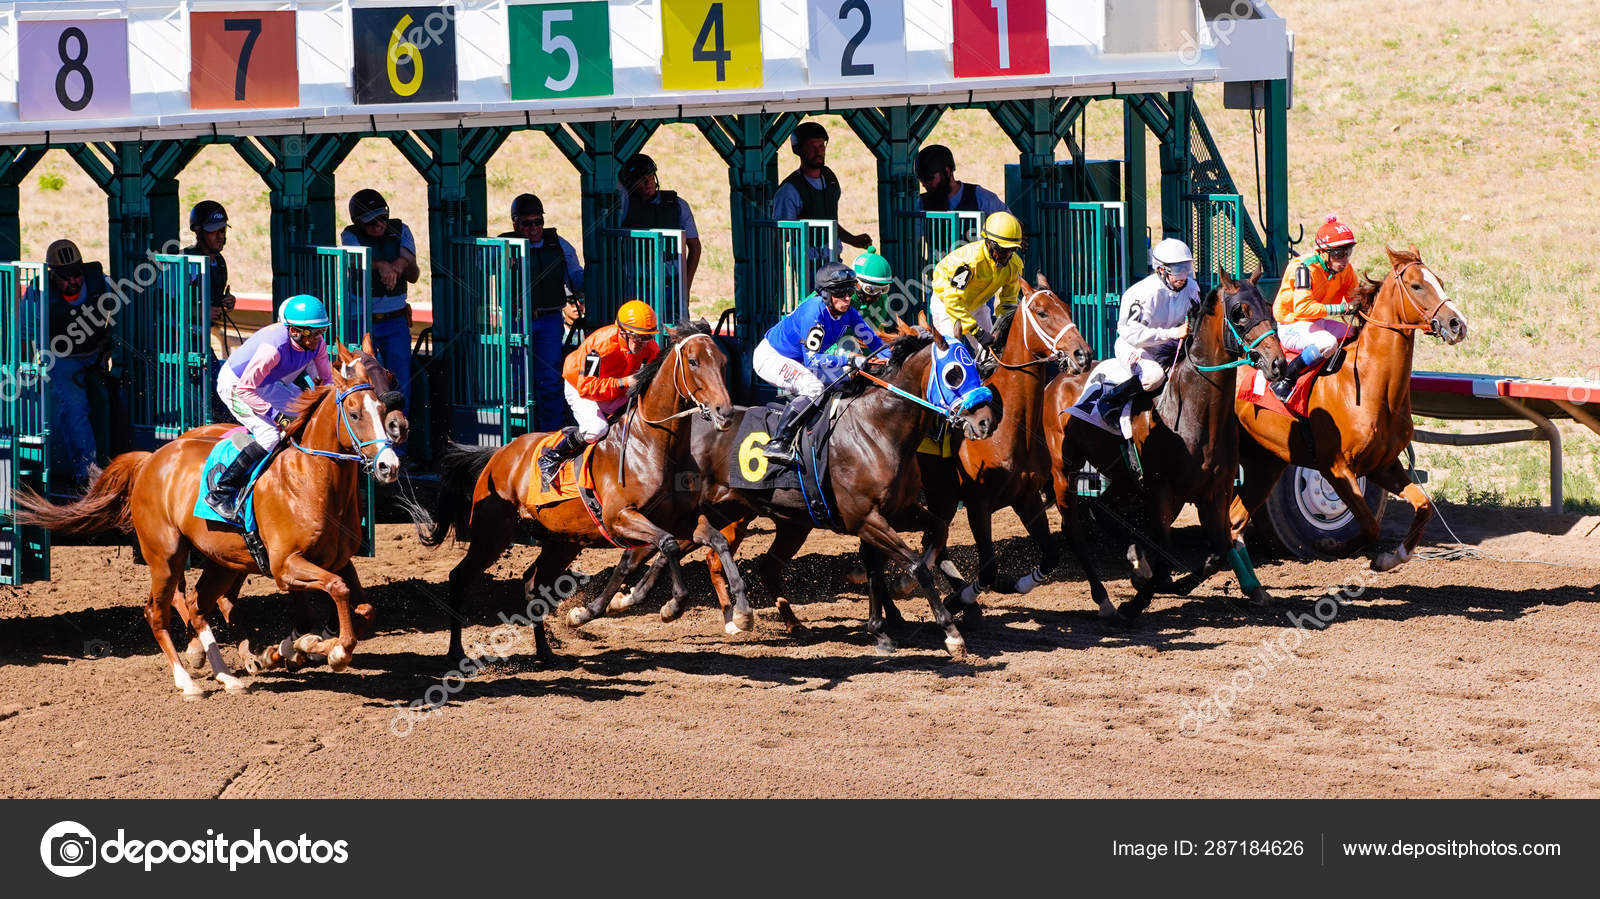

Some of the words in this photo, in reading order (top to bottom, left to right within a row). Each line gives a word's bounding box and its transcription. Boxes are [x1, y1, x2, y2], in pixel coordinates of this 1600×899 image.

[55, 27, 94, 112] 8
[223, 18, 262, 101] 7
[386, 13, 424, 97] 6
[541, 8, 579, 92] 5
[692, 2, 732, 82] 4
[838, 0, 875, 77] 2
[990, 0, 1010, 69] 1
[953, 270, 968, 289] 4
[1126, 303, 1142, 324] 2
[586, 356, 600, 377] 7
[806, 328, 824, 351] 6
[739, 432, 771, 482] 6
